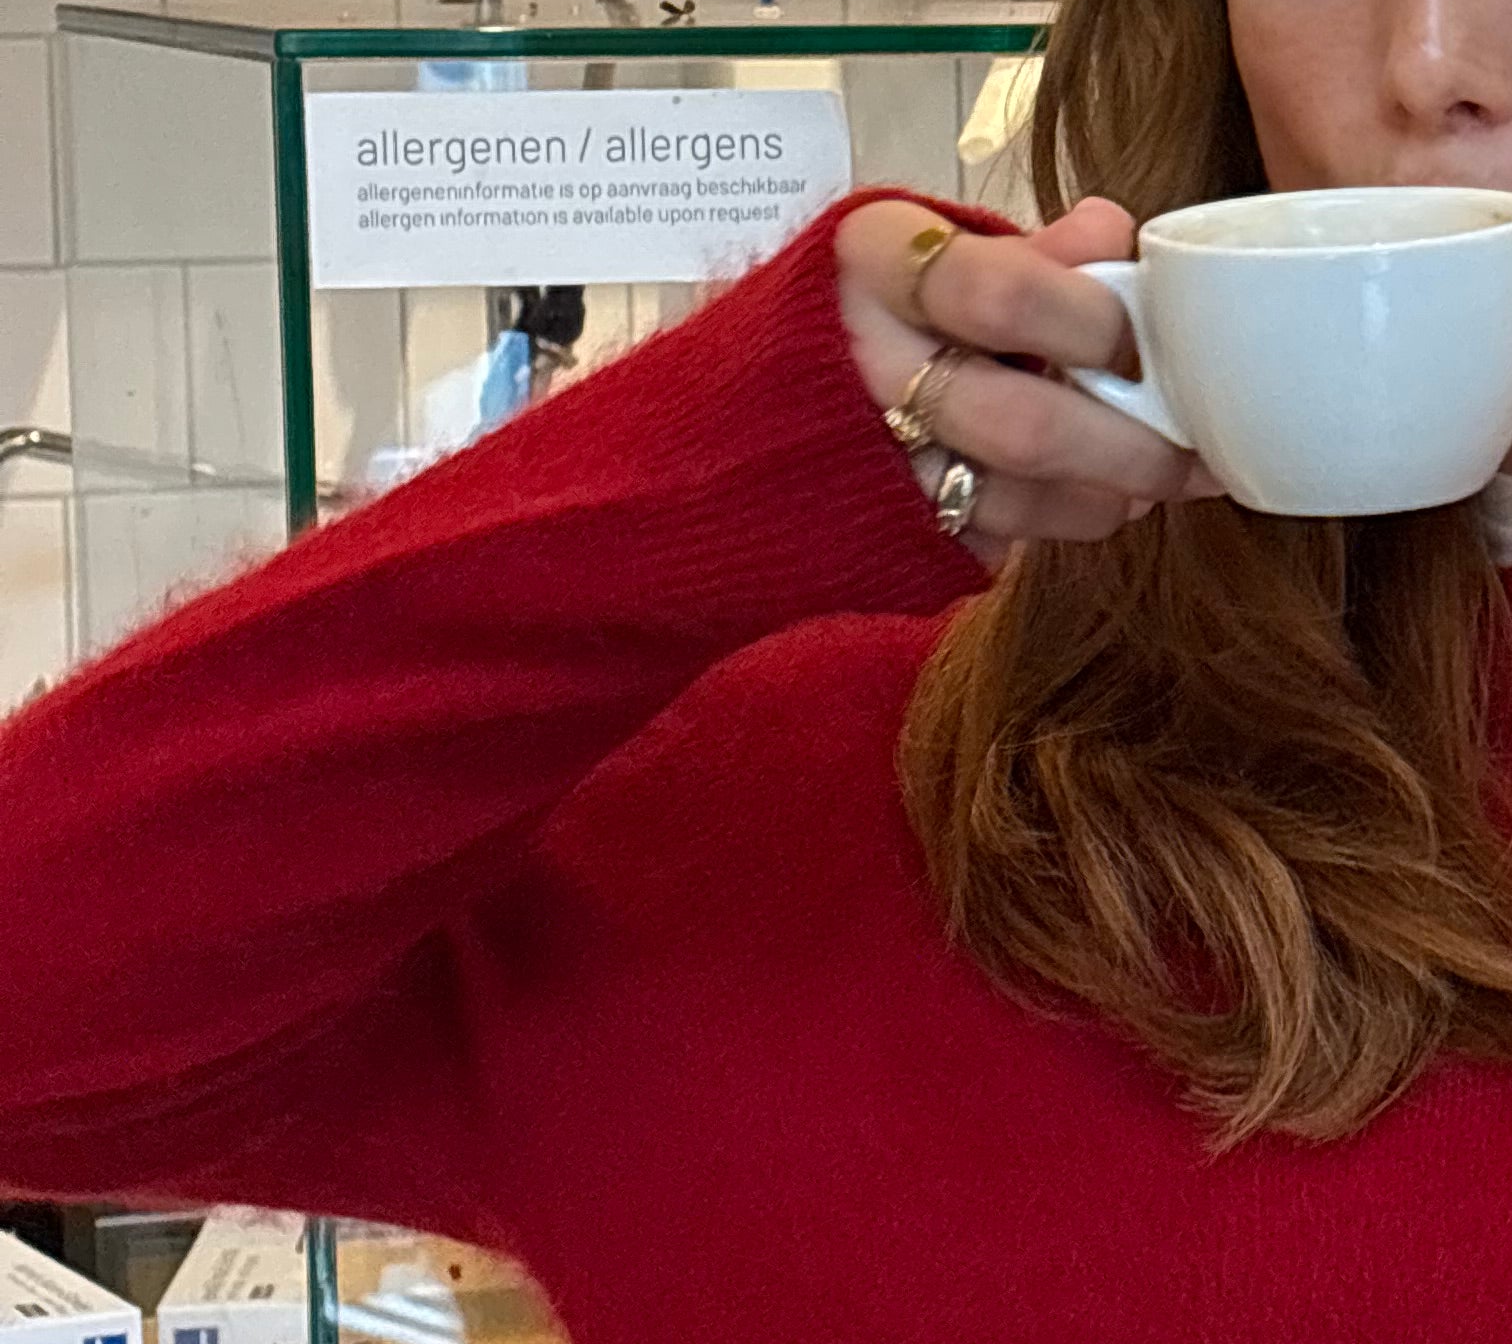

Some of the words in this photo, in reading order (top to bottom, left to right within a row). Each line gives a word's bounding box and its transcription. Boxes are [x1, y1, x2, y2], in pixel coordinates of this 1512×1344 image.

[357, 129, 567, 174] allergenen
[605, 125, 784, 170] allergens
[357, 181, 554, 205] allergeneninformatie
[559, 183, 575, 199] is
[578, 184, 603, 202] op
[606, 180, 692, 200] aanvraag
[696, 175, 807, 197] beschikbaar
[358, 209, 436, 232] allergen
[439, 206, 548, 228] information
[553, 208, 569, 226] is
[572, 205, 653, 226] available
[657, 205, 705, 227] upon
[708, 205, 780, 225] request
